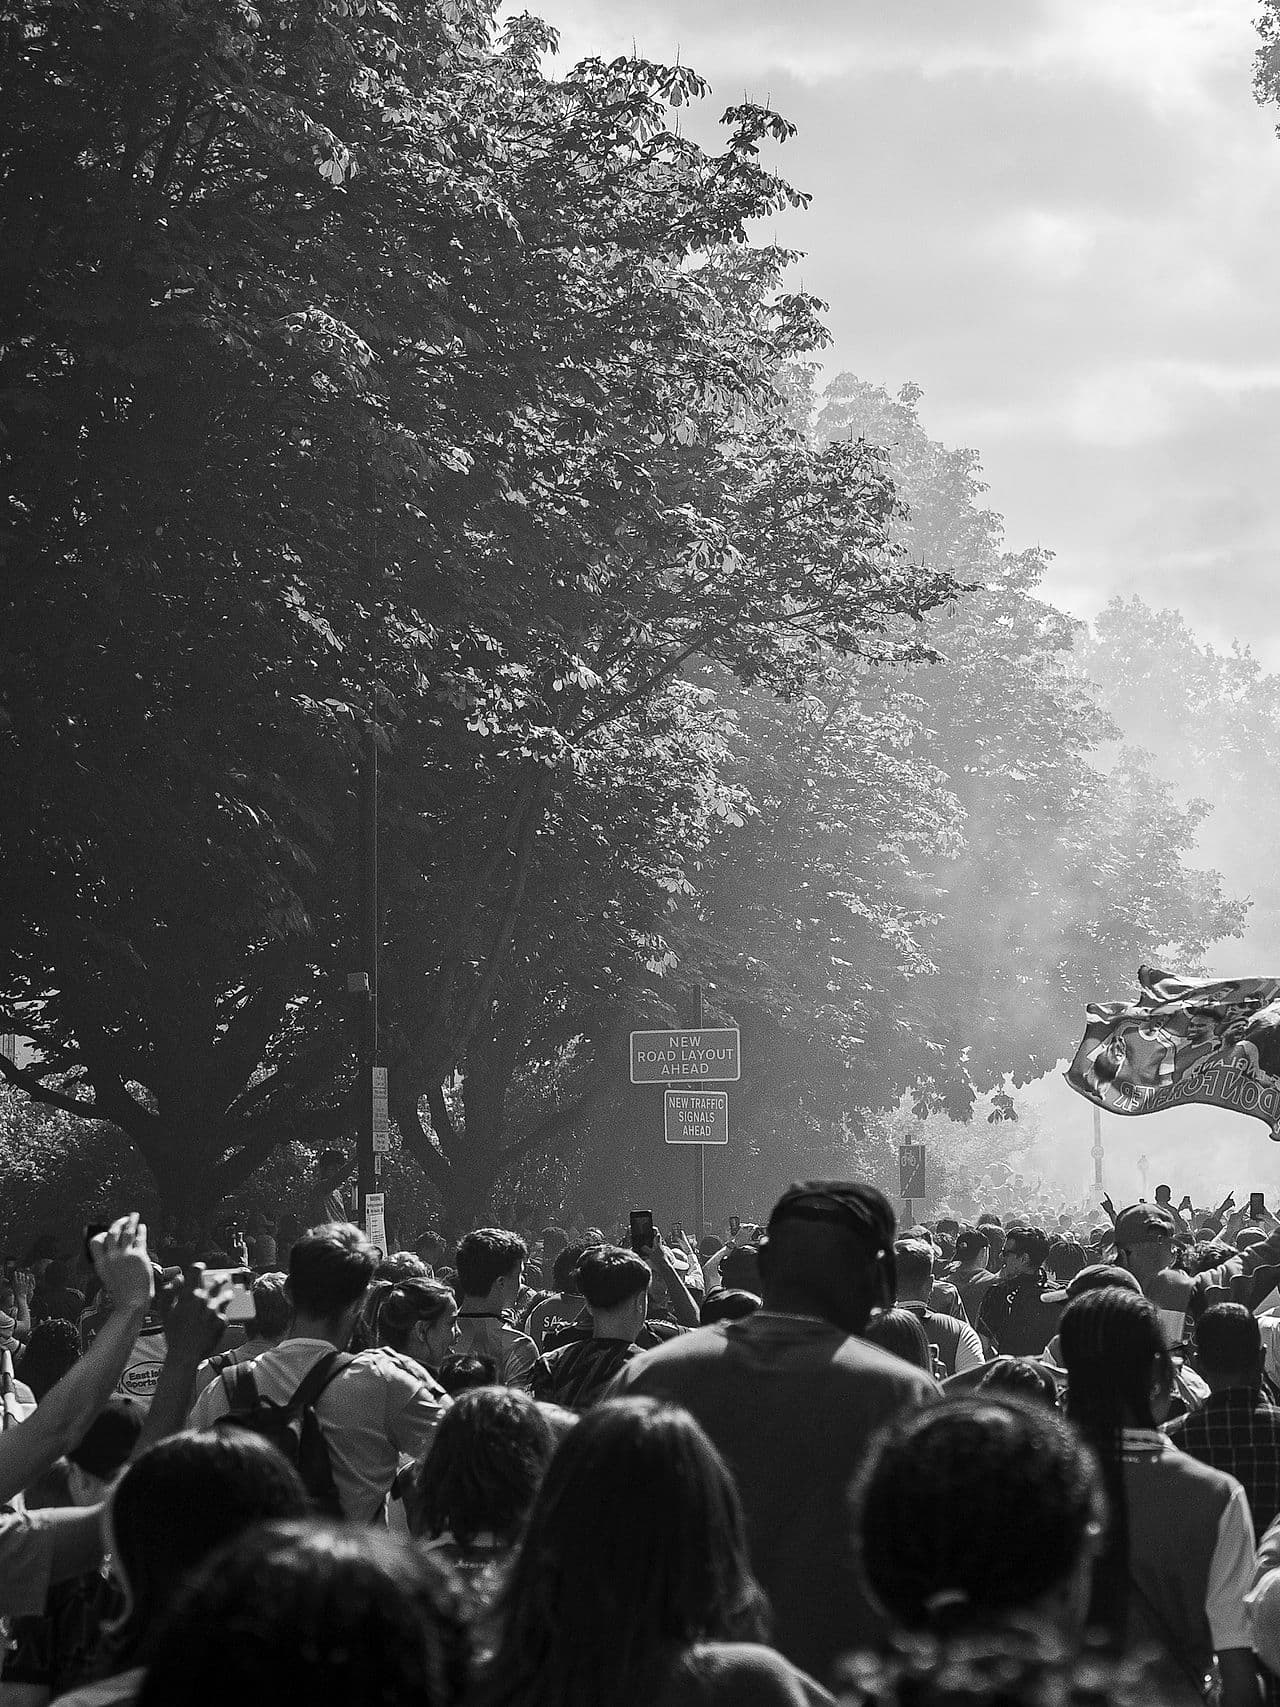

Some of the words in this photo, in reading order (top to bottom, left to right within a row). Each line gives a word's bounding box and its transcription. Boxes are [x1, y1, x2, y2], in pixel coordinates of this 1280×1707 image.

[669, 1036, 701, 1048] NEW
[638, 1050, 676, 1062] ROAD
[682, 1048, 734, 1061] LAYOUT
[661, 1063, 709, 1075] AHEAD
[669, 1097, 688, 1108] NEW
[690, 1097, 724, 1110] TRAFFIC
[678, 1111, 715, 1123] SIGNALS
[682, 1125, 711, 1136] AHEAD
[129, 1370, 150, 1381] East
